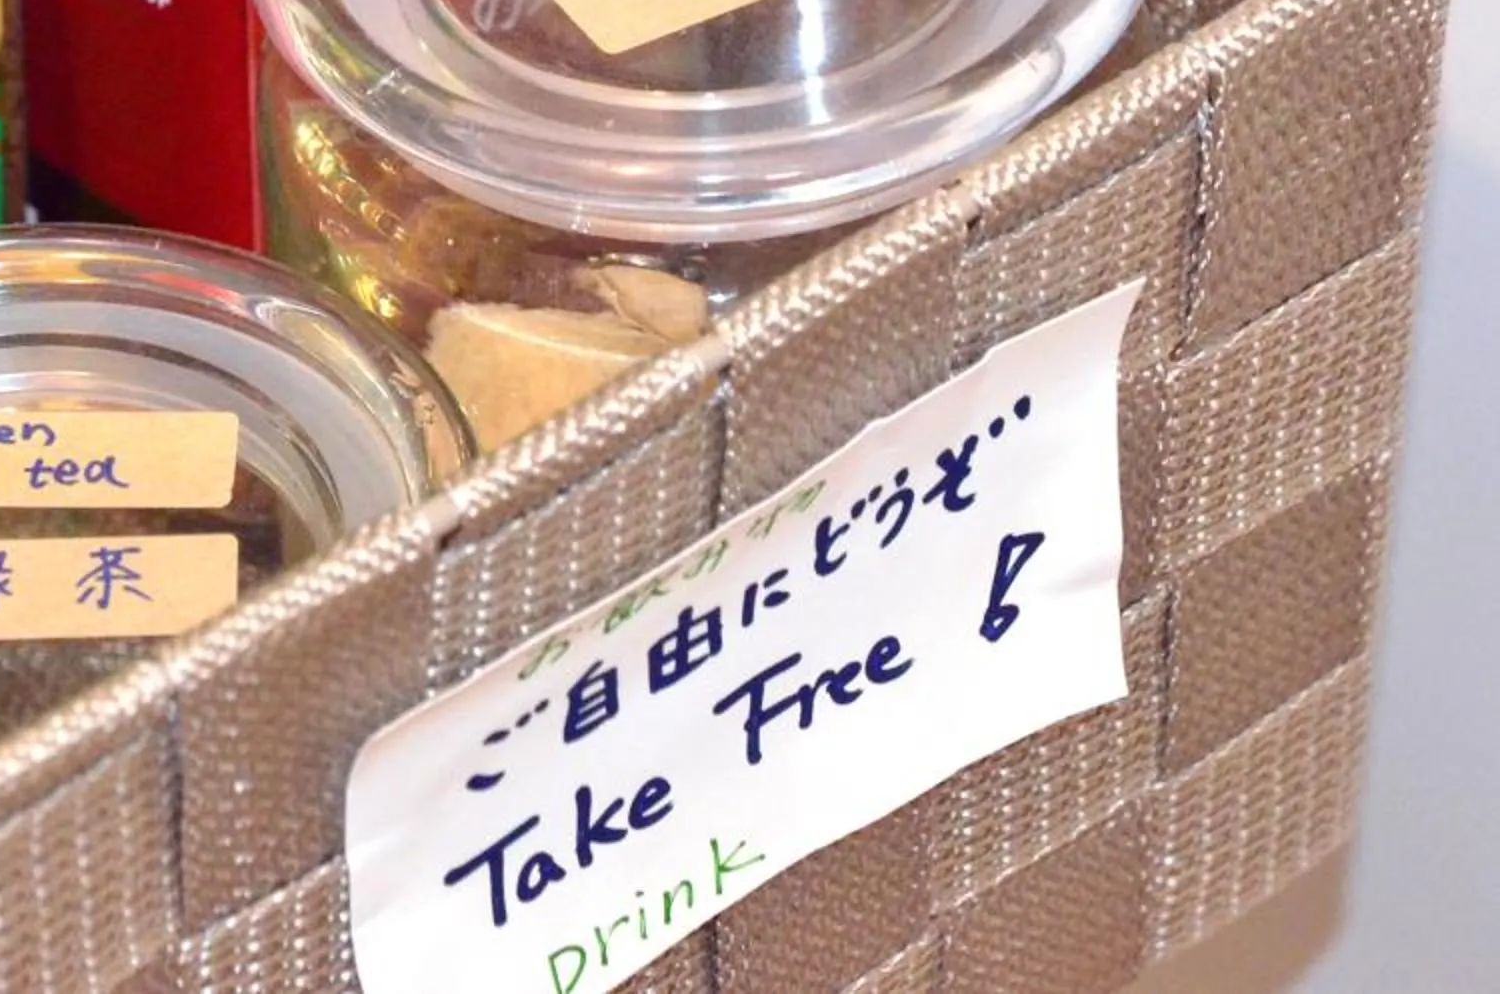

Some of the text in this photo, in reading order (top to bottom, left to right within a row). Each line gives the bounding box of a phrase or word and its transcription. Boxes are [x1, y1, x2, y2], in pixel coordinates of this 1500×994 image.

[24, 455, 130, 490] tea
[466, 395, 1033, 791] ご自由にどうぞ
[443, 776, 673, 927] Take
[712, 634, 914, 766] Free
[548, 838, 766, 994] Drink
